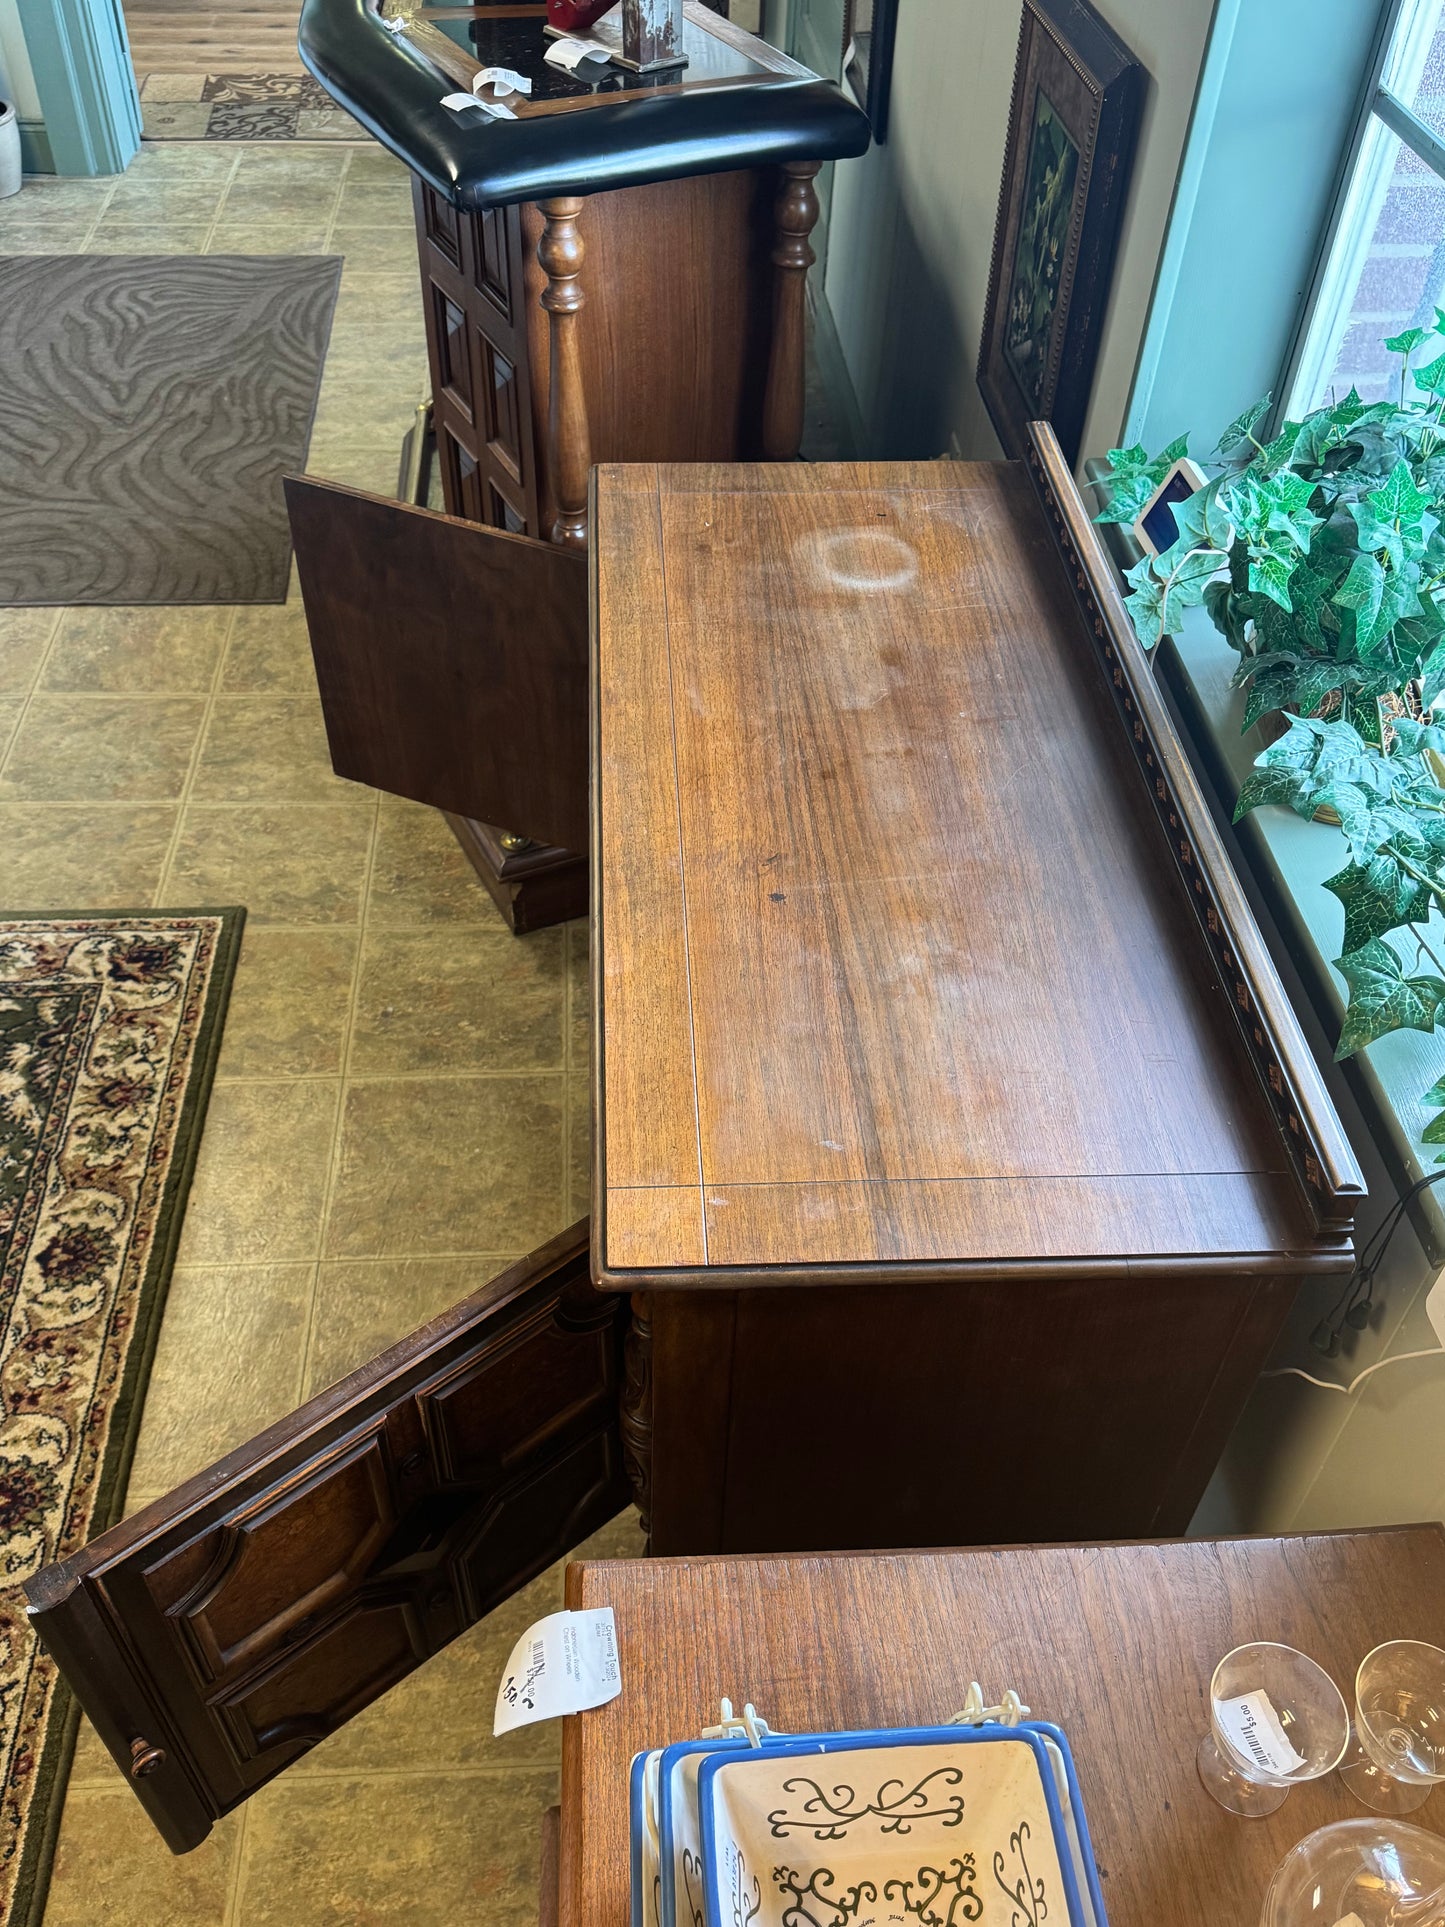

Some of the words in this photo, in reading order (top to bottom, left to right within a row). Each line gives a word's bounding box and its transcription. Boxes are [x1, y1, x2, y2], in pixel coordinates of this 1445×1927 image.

[606, 1625, 614, 1657] Crowning
[609, 1659, 617, 1680] Touch
[1240, 1704, 1257, 1727] $5.00
